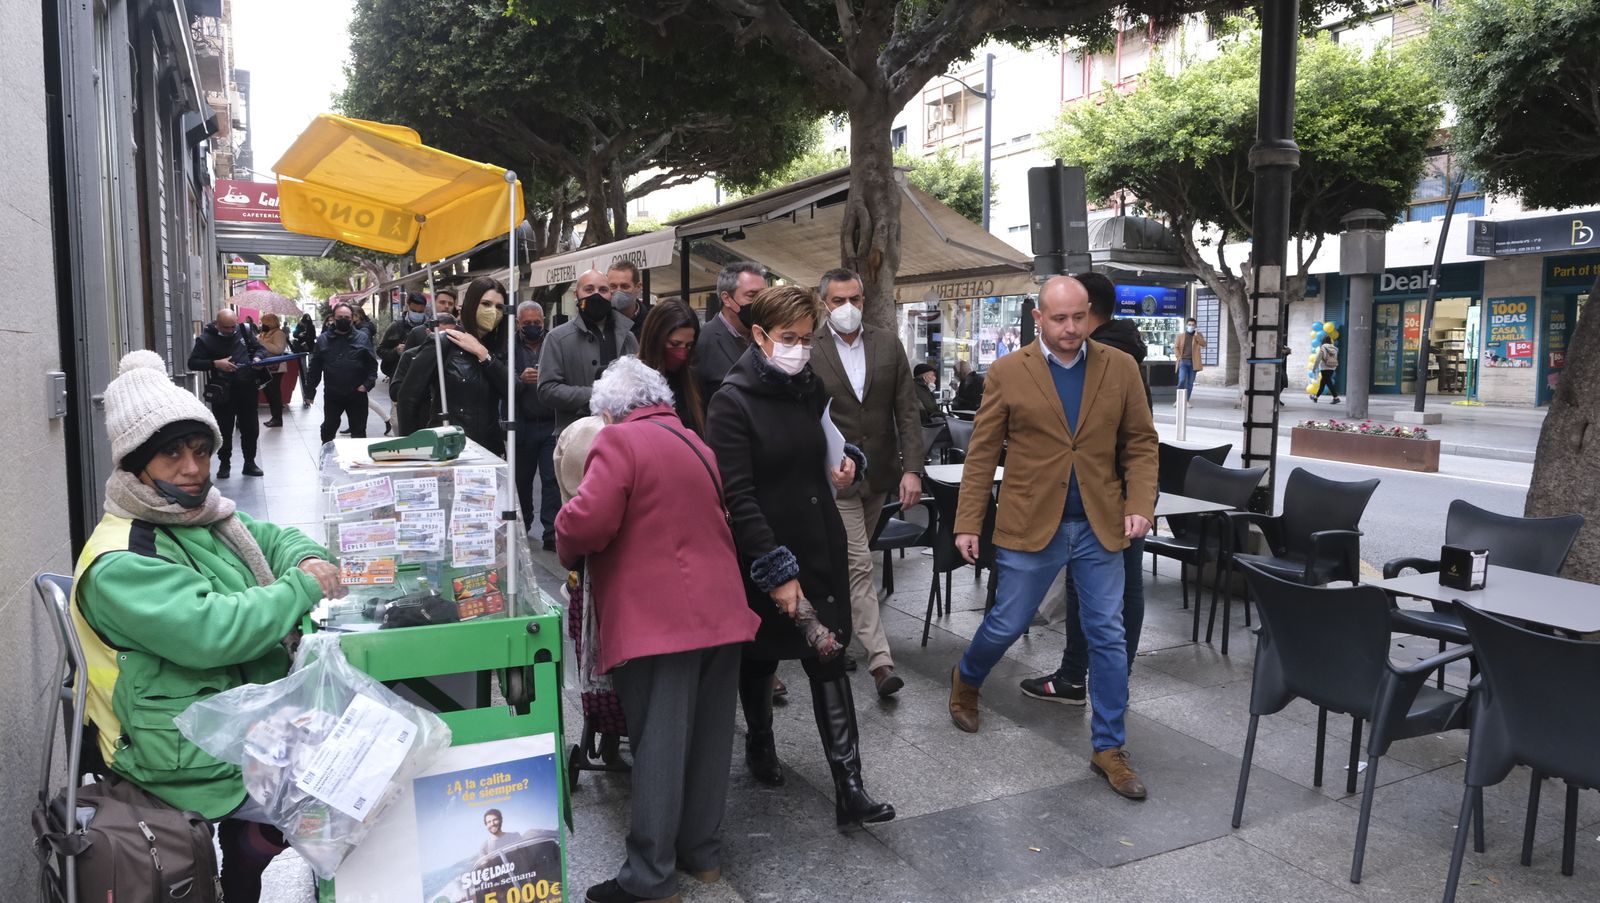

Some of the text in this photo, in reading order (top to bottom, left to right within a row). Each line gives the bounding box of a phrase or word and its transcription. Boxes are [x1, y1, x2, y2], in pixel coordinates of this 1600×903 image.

[546, 265, 576, 283] CAFETERIA
[1553, 266, 1576, 277] Part
[1578, 264, 1589, 276] of
[1380, 270, 1440, 291] Deal
[1492, 302, 1527, 315] 1000
[1491, 313, 1527, 324] IDEAS
[1491, 326, 1517, 334] CASA
[1491, 333, 1526, 341] FAMILIA
[447, 772, 511, 795] ¿A la calita
[462, 778, 529, 801] de siempre?
[500, 870, 537, 885] semana
[484, 879, 561, 903] 5000€
